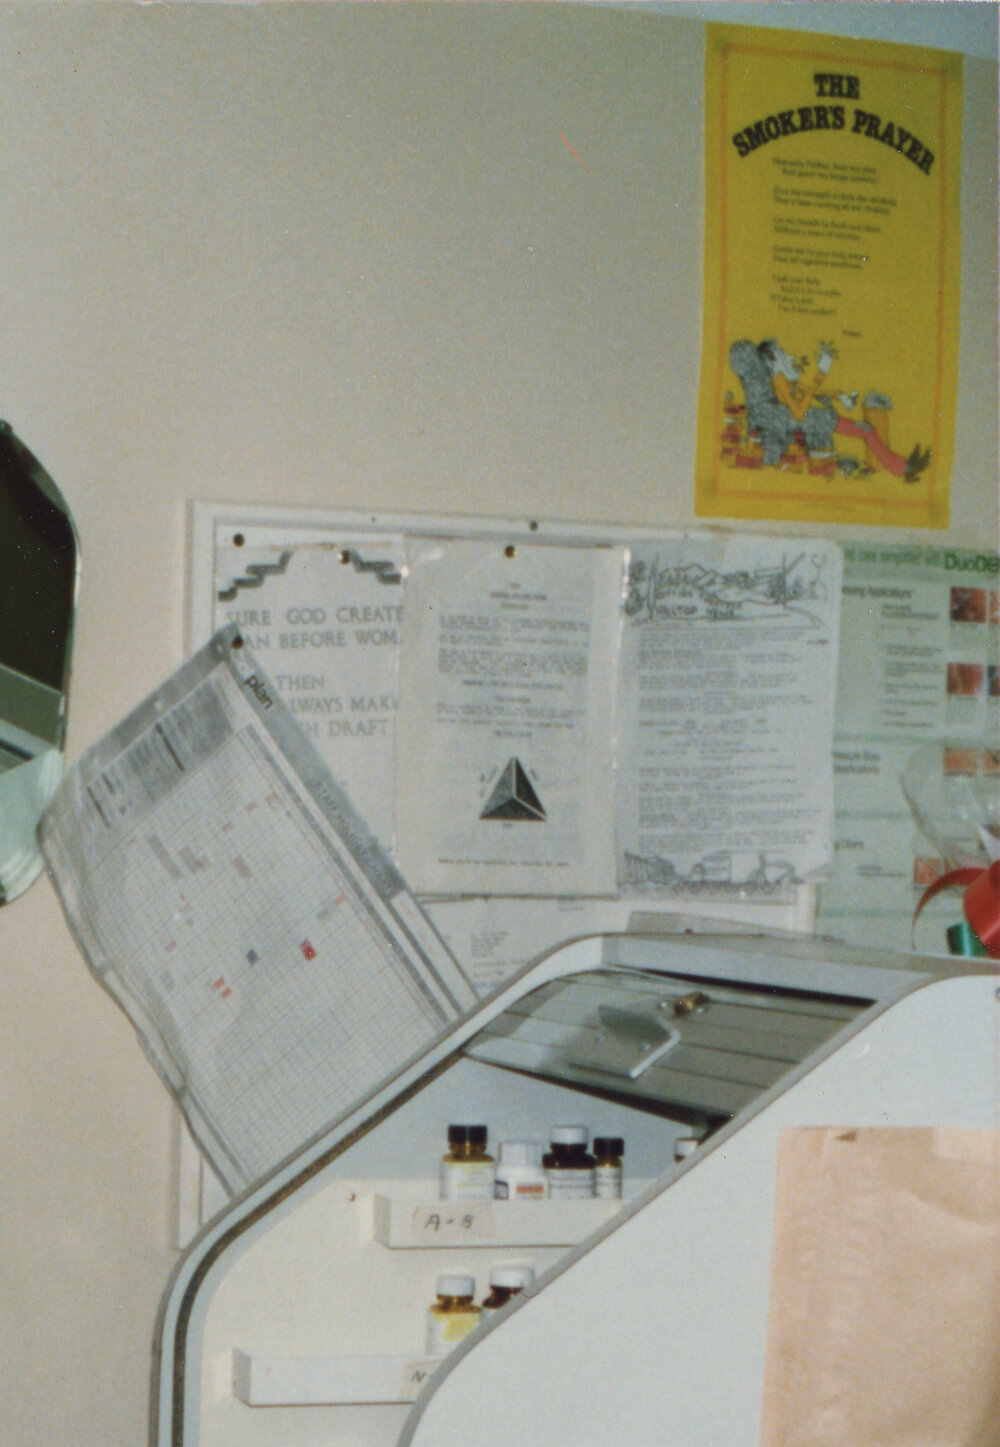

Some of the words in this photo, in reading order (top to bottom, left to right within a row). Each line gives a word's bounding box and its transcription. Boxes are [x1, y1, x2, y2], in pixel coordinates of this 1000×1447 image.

[814, 73, 860, 100] THE
[732, 105, 845, 158] SMOKER'S
[851, 109, 935, 176] PRAYER
[226, 609, 271, 626] SURE
[286, 607, 326, 625] GOD
[280, 631, 346, 649] BEFORE
[275, 674, 324, 691] THEN
[243, 676, 273, 710] plan
[288, 697, 343, 713] LWAYS
[330, 718, 389, 736] DRAFT
